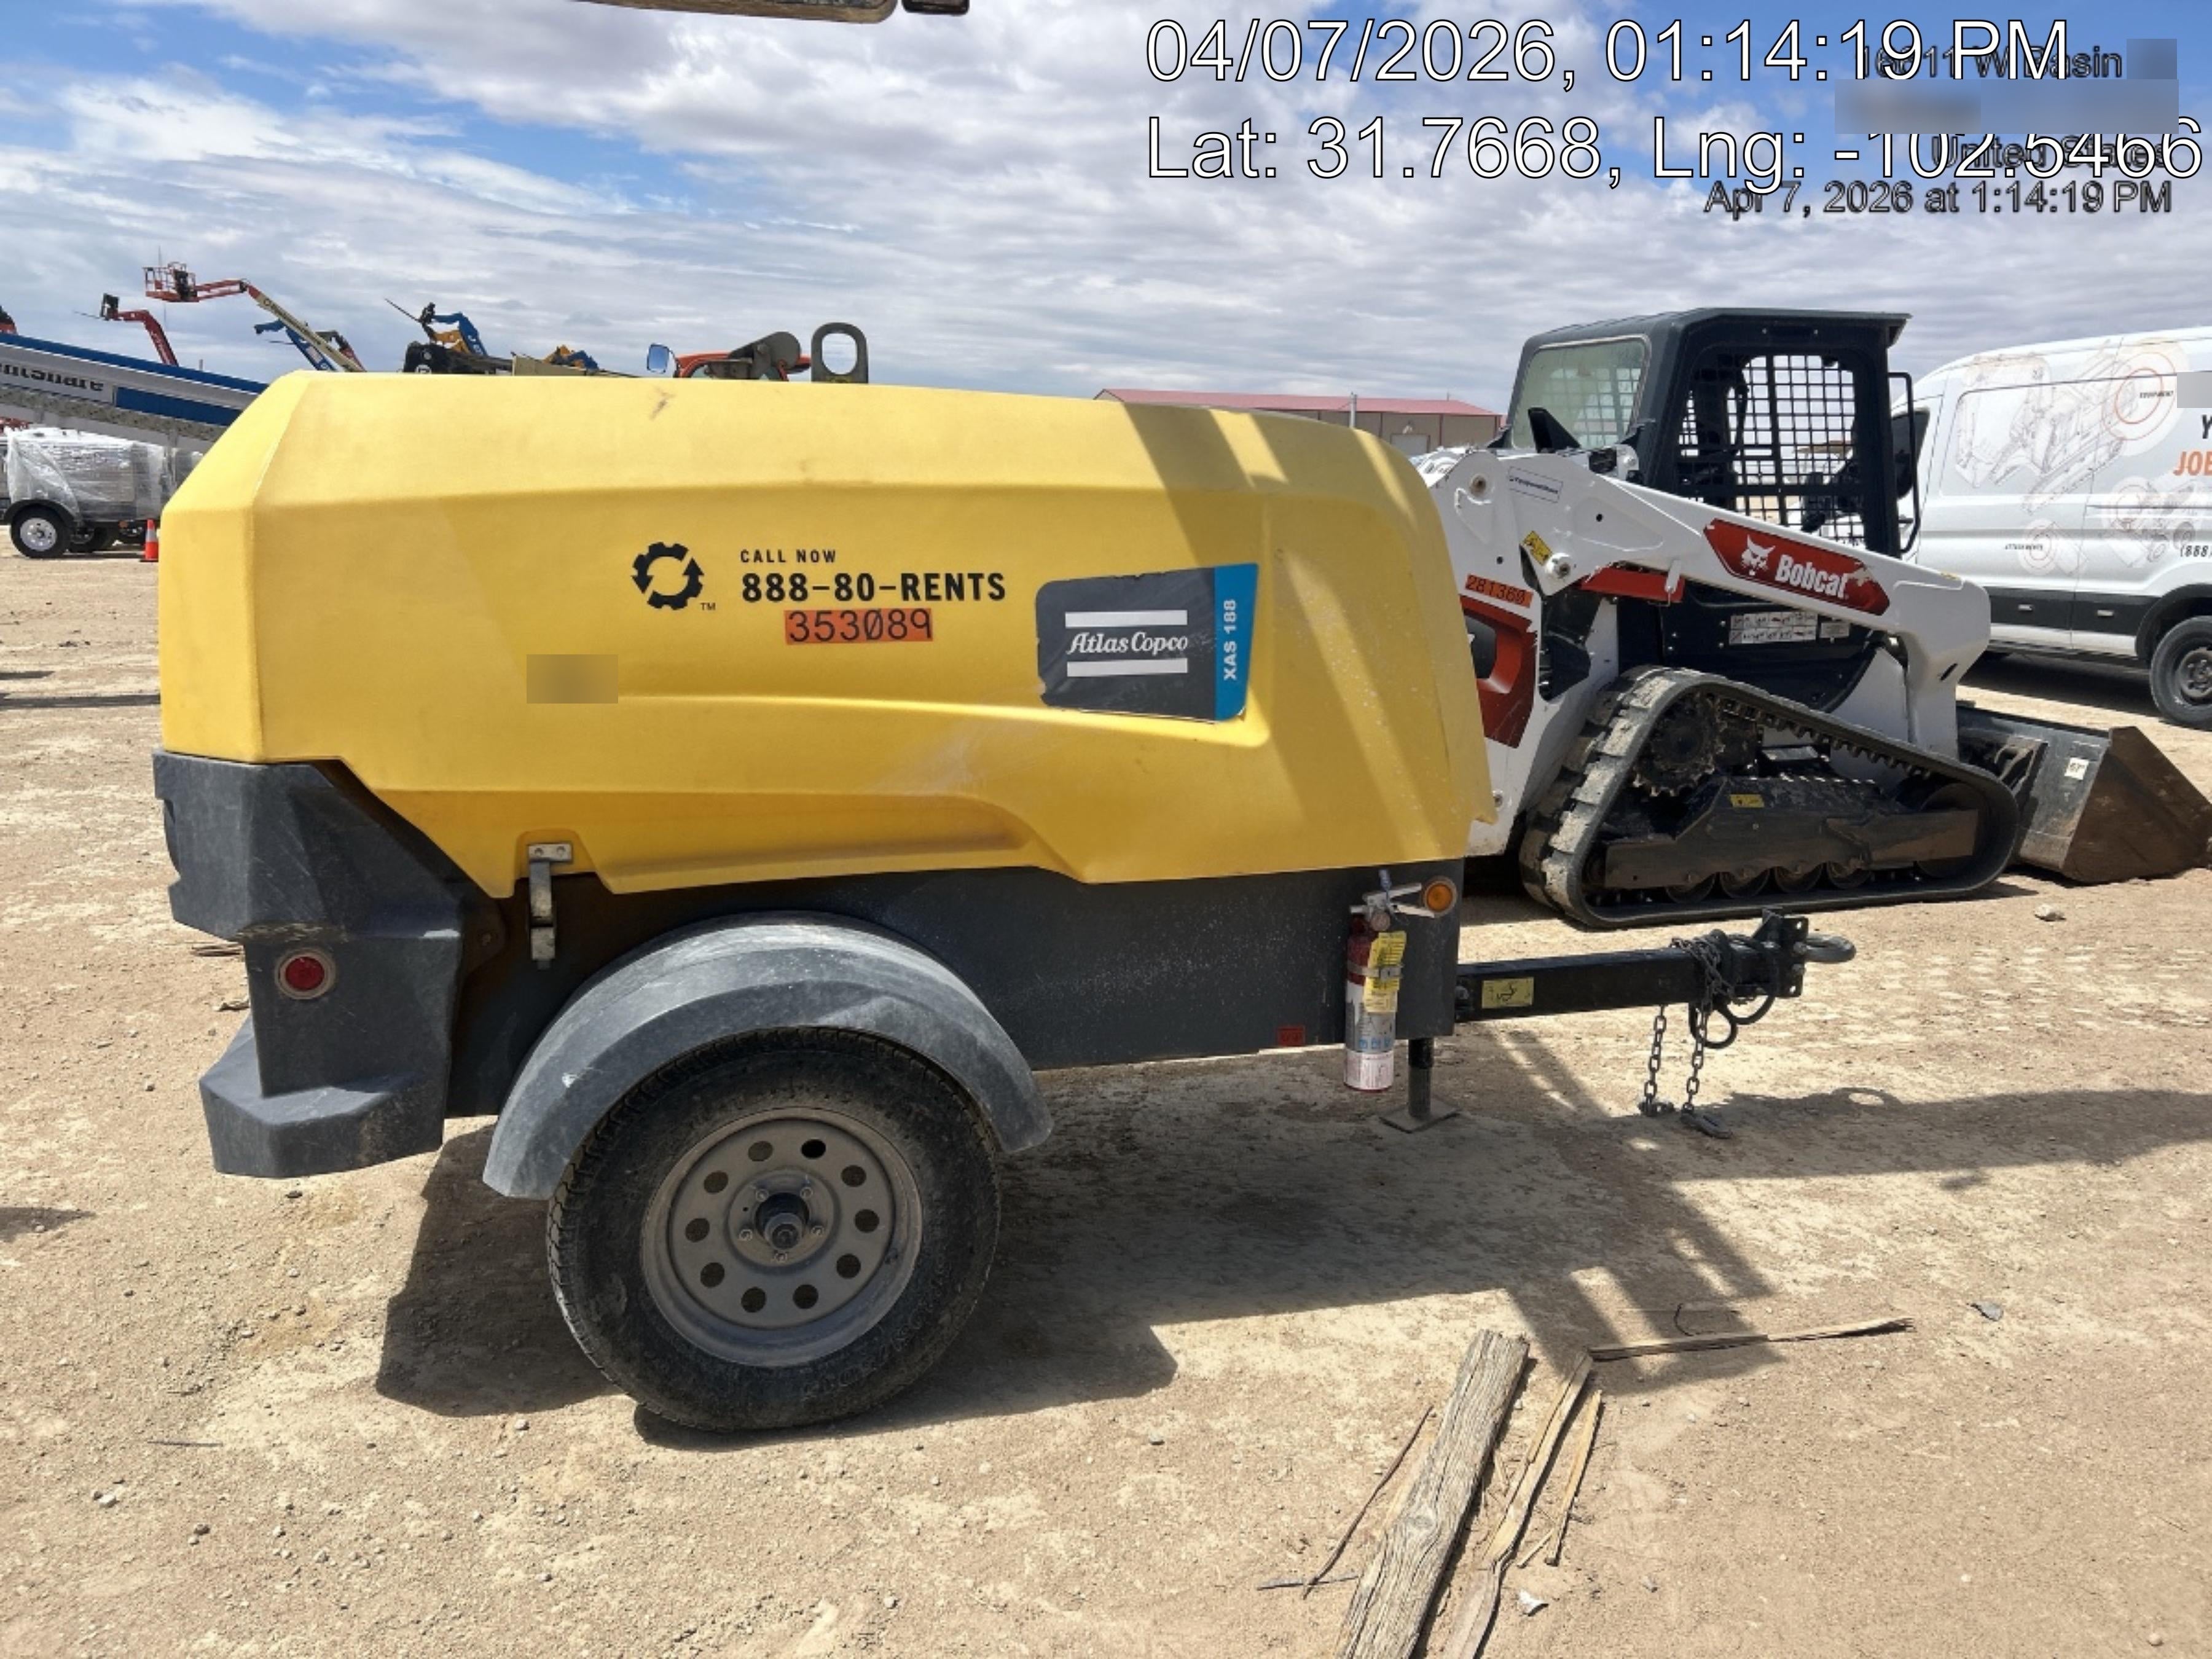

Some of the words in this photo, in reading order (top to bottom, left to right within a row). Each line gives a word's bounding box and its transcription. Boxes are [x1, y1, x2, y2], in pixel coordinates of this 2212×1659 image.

[740, 549, 786, 563] CALL
[796, 549, 836, 563] NOW
[742, 572, 1006, 603] 888-80-RENTS
[1775, 554, 1849, 599] Bobcat
[788, 607, 931, 643] 353089
[1223, 599, 1237, 635] 188
[1066, 632, 1128, 654] Atlas
[1131, 631, 1189, 656] Copco
[1223, 640, 1237, 681] XAS
